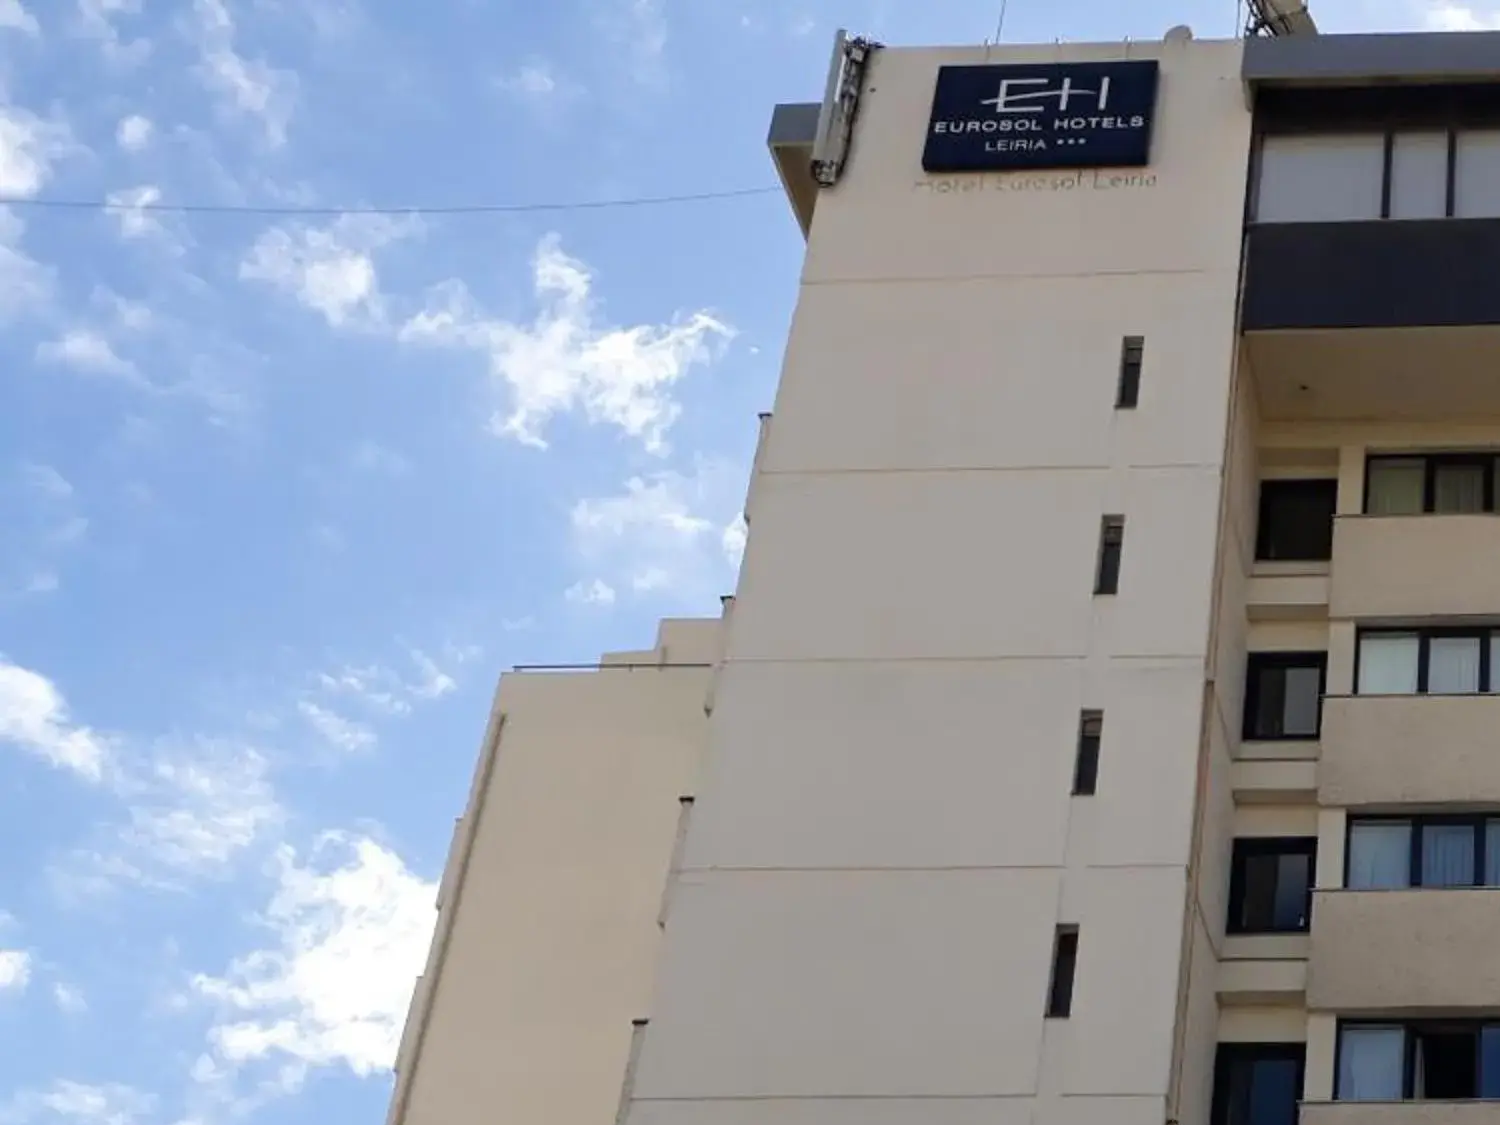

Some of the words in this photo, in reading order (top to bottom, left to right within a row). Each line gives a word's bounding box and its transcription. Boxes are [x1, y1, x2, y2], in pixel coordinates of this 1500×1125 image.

[934, 117, 1042, 134] EUROSOL
[1053, 115, 1144, 130] HOTELS
[984, 138, 1047, 152] LEIRIA
